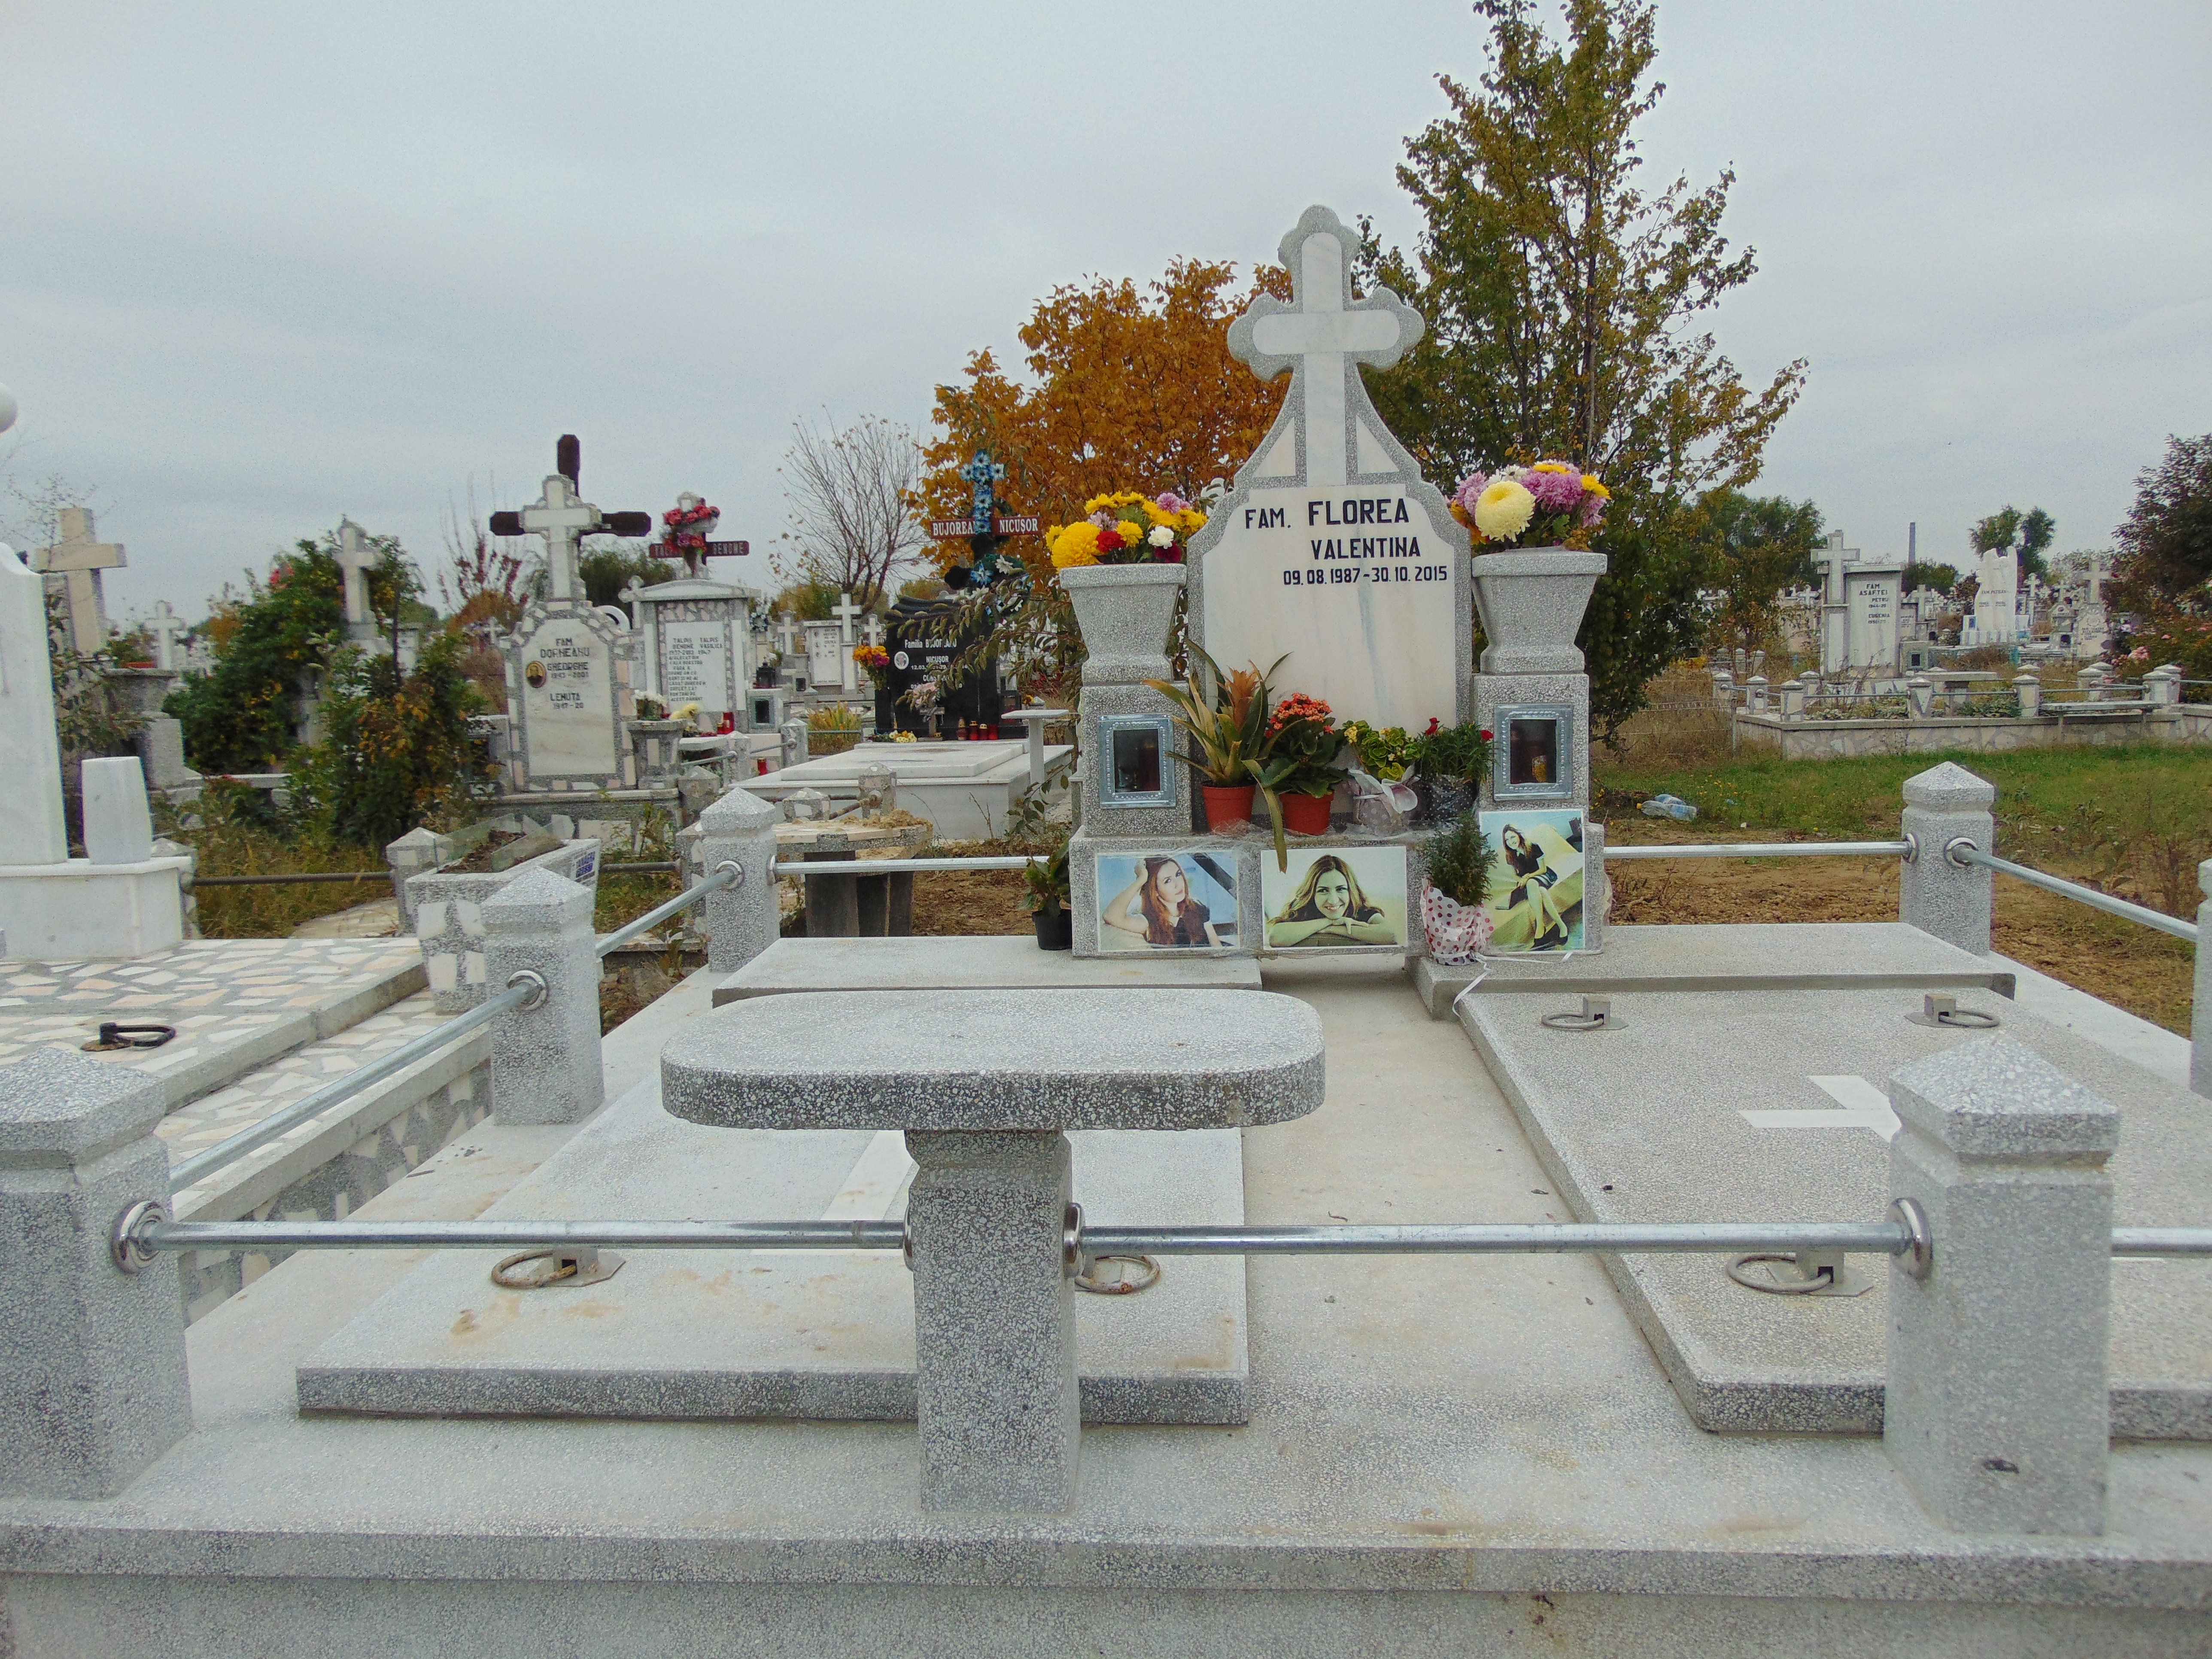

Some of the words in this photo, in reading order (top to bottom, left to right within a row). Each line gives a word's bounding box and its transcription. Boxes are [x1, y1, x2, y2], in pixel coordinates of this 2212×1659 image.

[1245, 507, 1291, 529] FAM.
[1308, 498, 1410, 526] FLOREA
[932, 521, 975, 536] BUJOREA
[1310, 537, 1421, 560] VALENTINA
[556, 638, 573, 646] FAM
[904, 639, 923, 648] Familia
[547, 662, 589, 671] GHEORGHE
